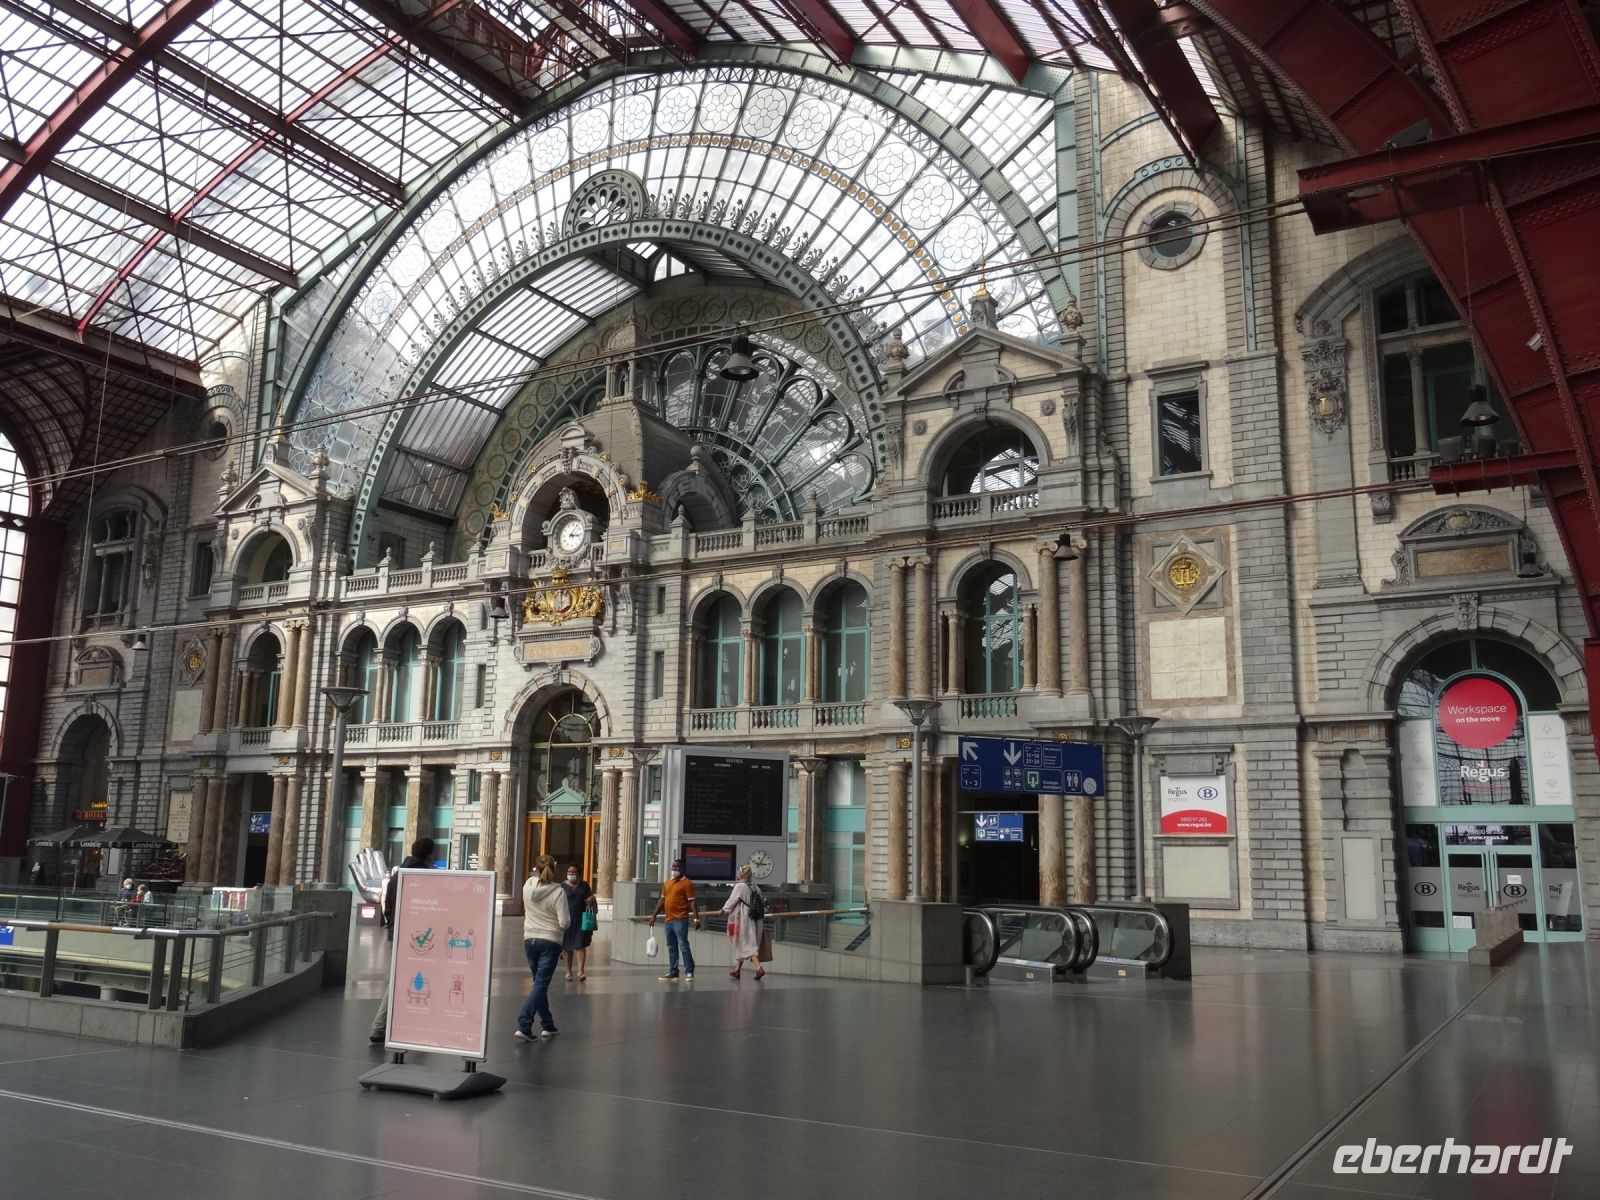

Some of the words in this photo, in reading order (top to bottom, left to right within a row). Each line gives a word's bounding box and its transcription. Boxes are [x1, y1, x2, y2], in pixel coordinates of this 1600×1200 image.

[1447, 705, 1507, 715] Workspace
[1460, 765, 1505, 782] Regus
[1168, 788, 1187, 797] Regus
[1458, 883, 1480, 893] Regus
